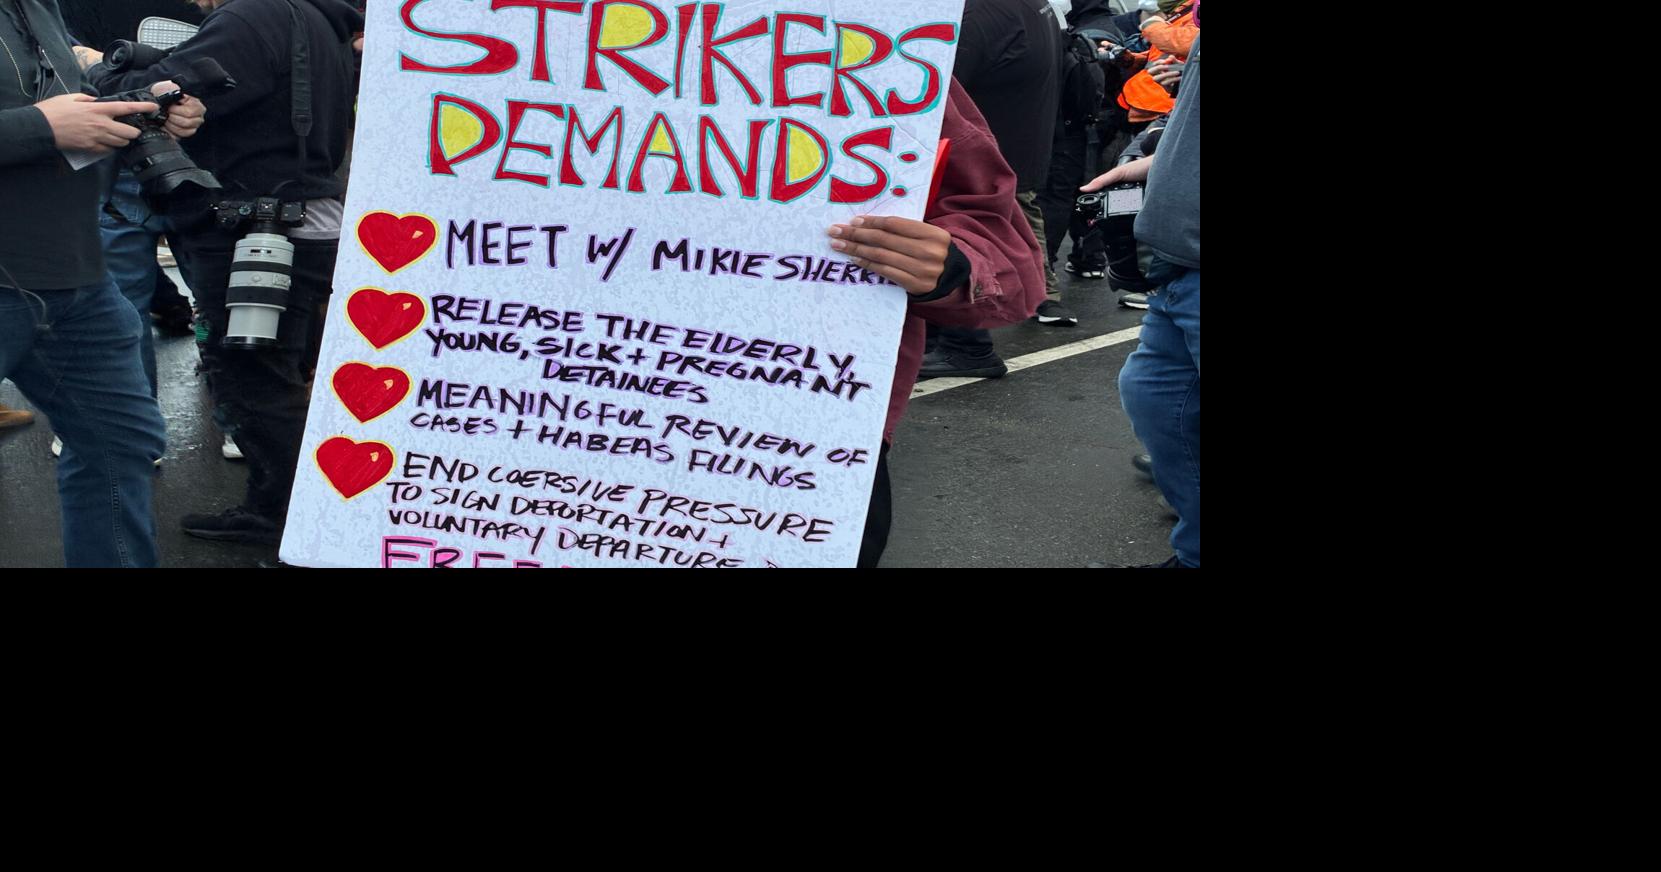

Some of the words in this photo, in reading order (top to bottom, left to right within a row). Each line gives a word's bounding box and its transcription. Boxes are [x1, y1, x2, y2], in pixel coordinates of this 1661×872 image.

[398, 0, 960, 117] STRIKERS
[427, 91, 919, 203] DEMANDS:
[446, 218, 570, 270] MEET
[652, 237, 772, 281] MIKIE
[431, 294, 584, 333] RELEASE
[596, 313, 678, 346] THE
[425, 328, 530, 361] YOUNG,
[533, 336, 624, 365] SICK
[626, 347, 653, 367] +
[655, 350, 873, 402] PREGNANT
[542, 357, 710, 404] DETAINEES
[409, 411, 499, 436] CASES
[507, 419, 535, 440] +
[536, 424, 677, 463] HABEAS
[687, 448, 818, 491] FILINGS
[415, 378, 655, 428] MEANINGFUL
[661, 413, 816, 459] REVIEW
[826, 447, 870, 467] OF
[386, 480, 424, 505] TO
[429, 486, 501, 513] SIGN
[510, 494, 707, 543] DEPORTATION
[388, 508, 546, 556] VOLUNTARY
[402, 450, 480, 484] END
[486, 465, 636, 502] COERSIVE
[636, 488, 835, 543] PRESSURE
